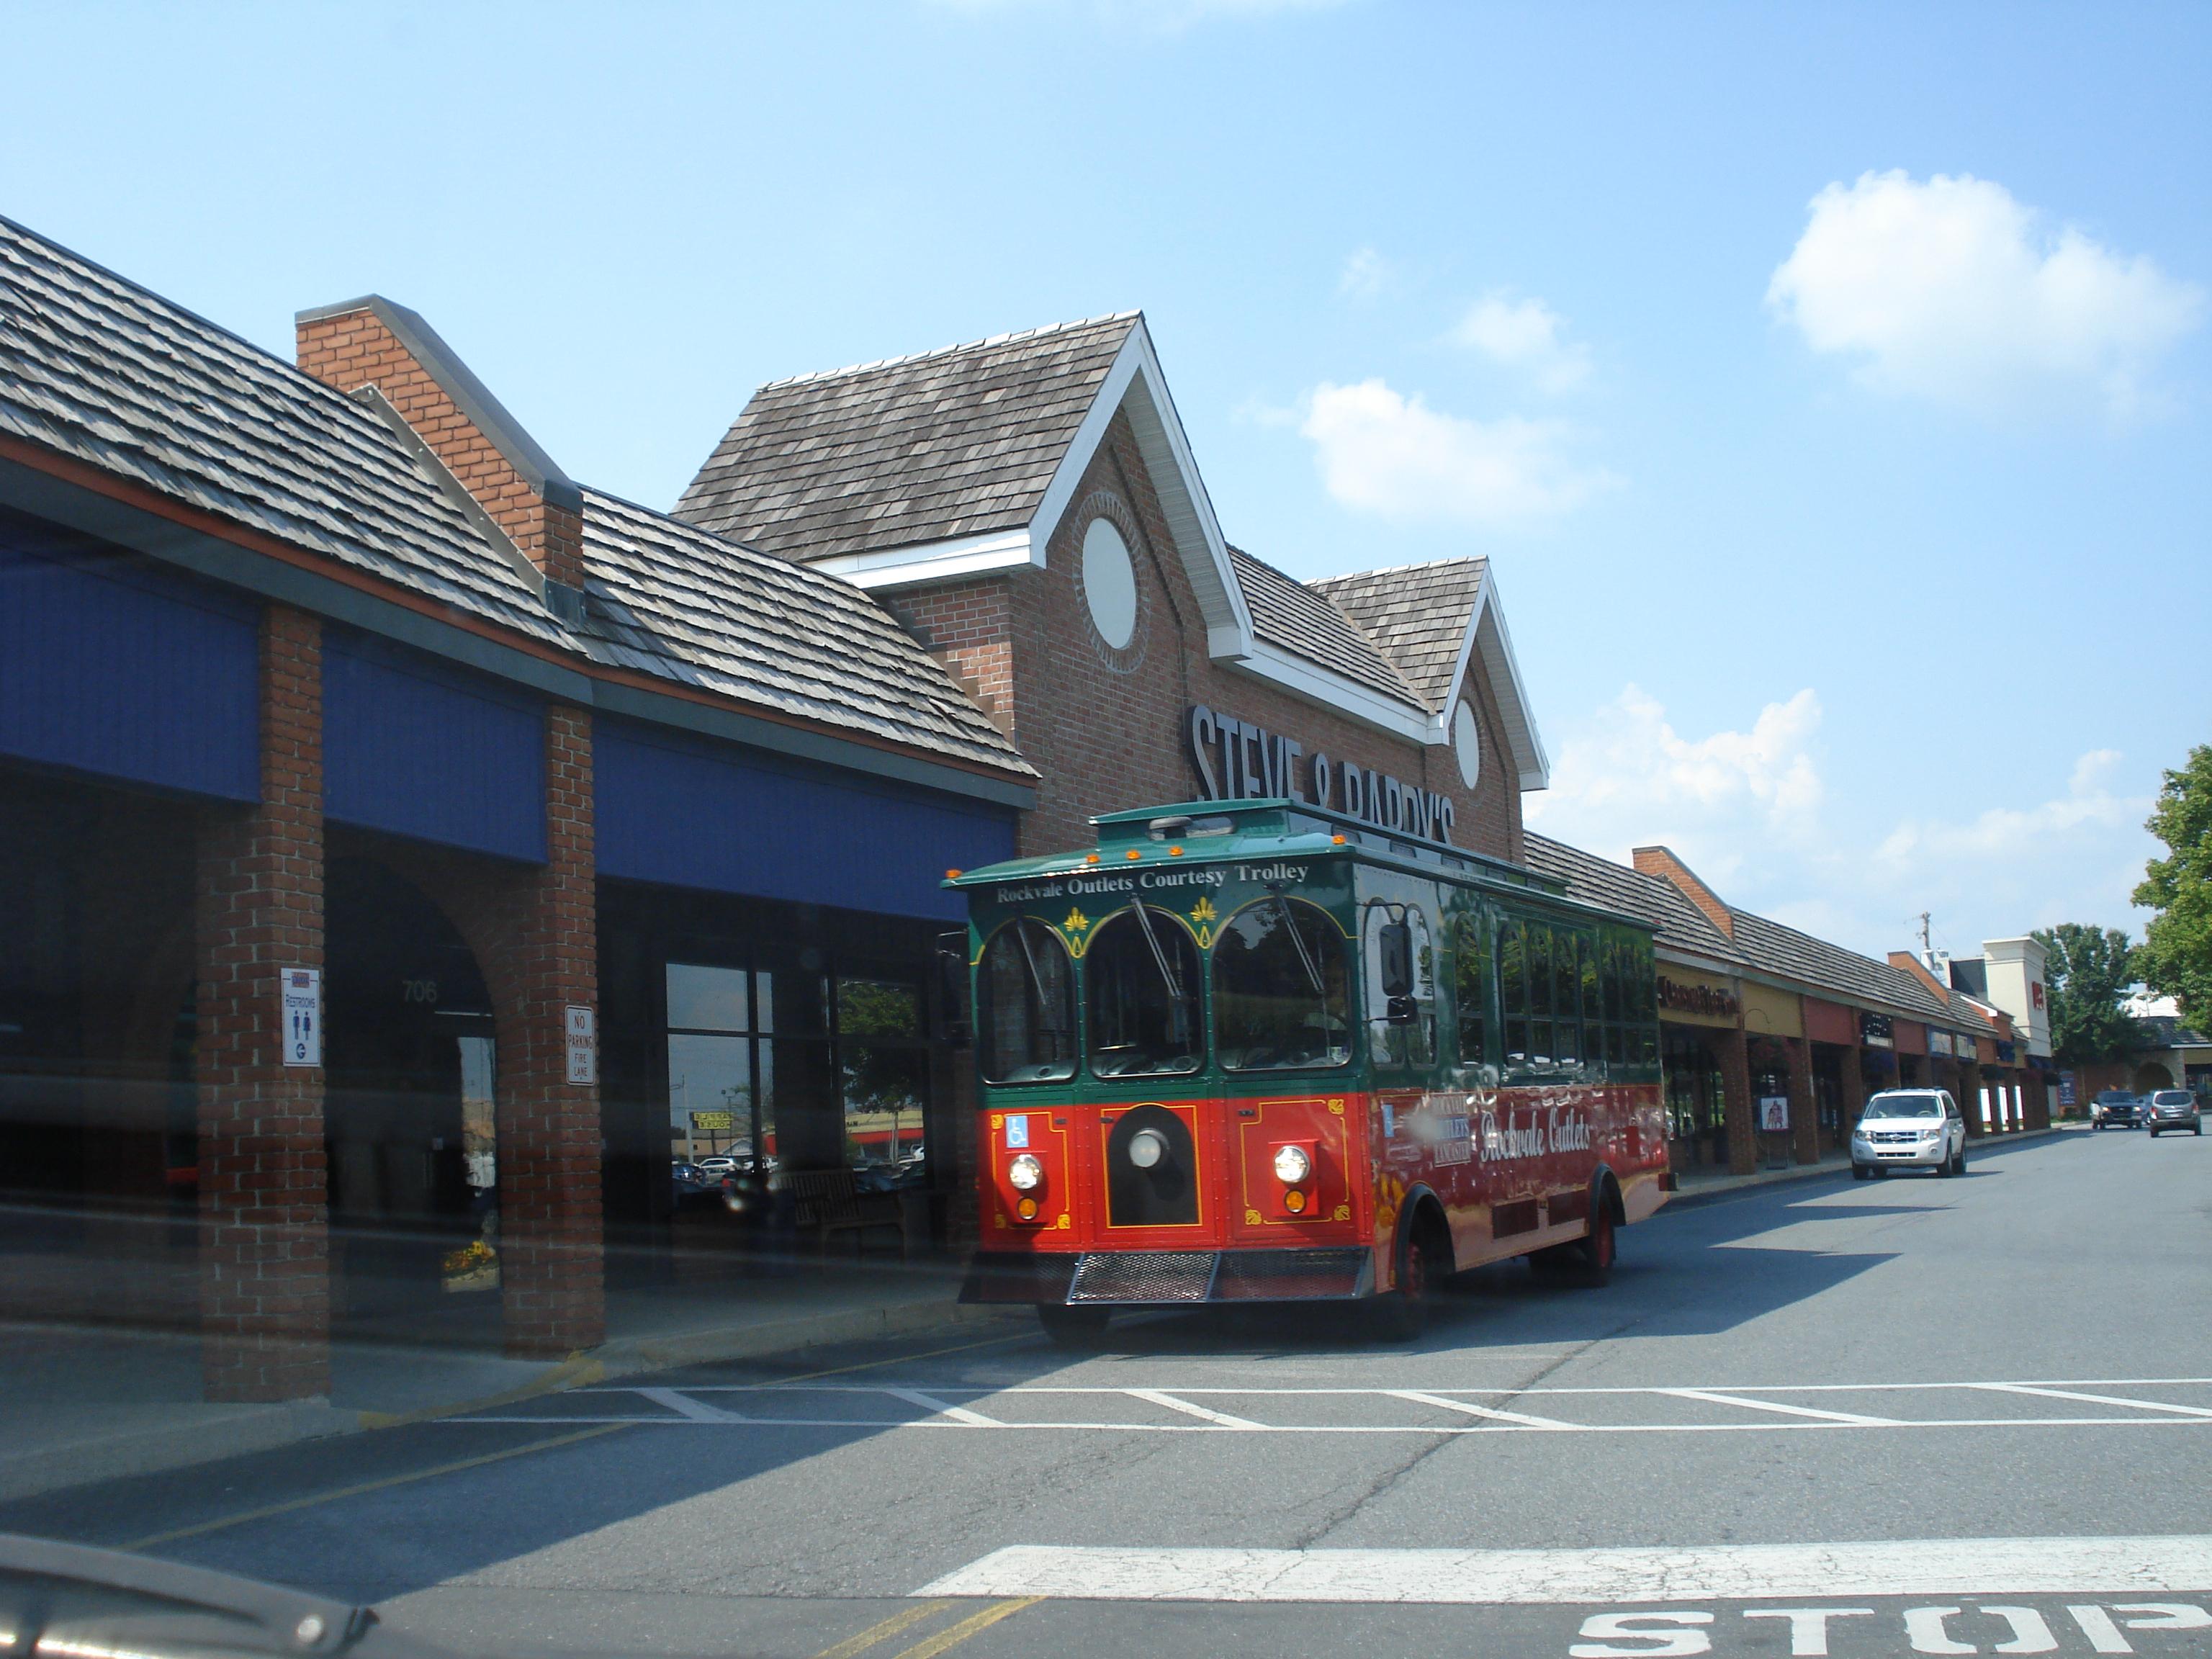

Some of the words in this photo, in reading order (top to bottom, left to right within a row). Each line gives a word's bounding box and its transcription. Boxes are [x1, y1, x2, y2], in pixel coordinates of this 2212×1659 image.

[997, 884, 1063, 904] Rockvale
[1068, 875, 1134, 895] Outlets
[1140, 868, 1228, 888] Courtesy
[1234, 863, 1309, 884] Trolley
[403, 980, 437, 1002] 706
[574, 1015, 585, 1030] NO
[568, 1034, 593, 1049] PARKING
[575, 1053, 587, 1064] FIRE
[574, 1066, 588, 1077] LANE
[1568, 1602, 2212, 1658] STOP
